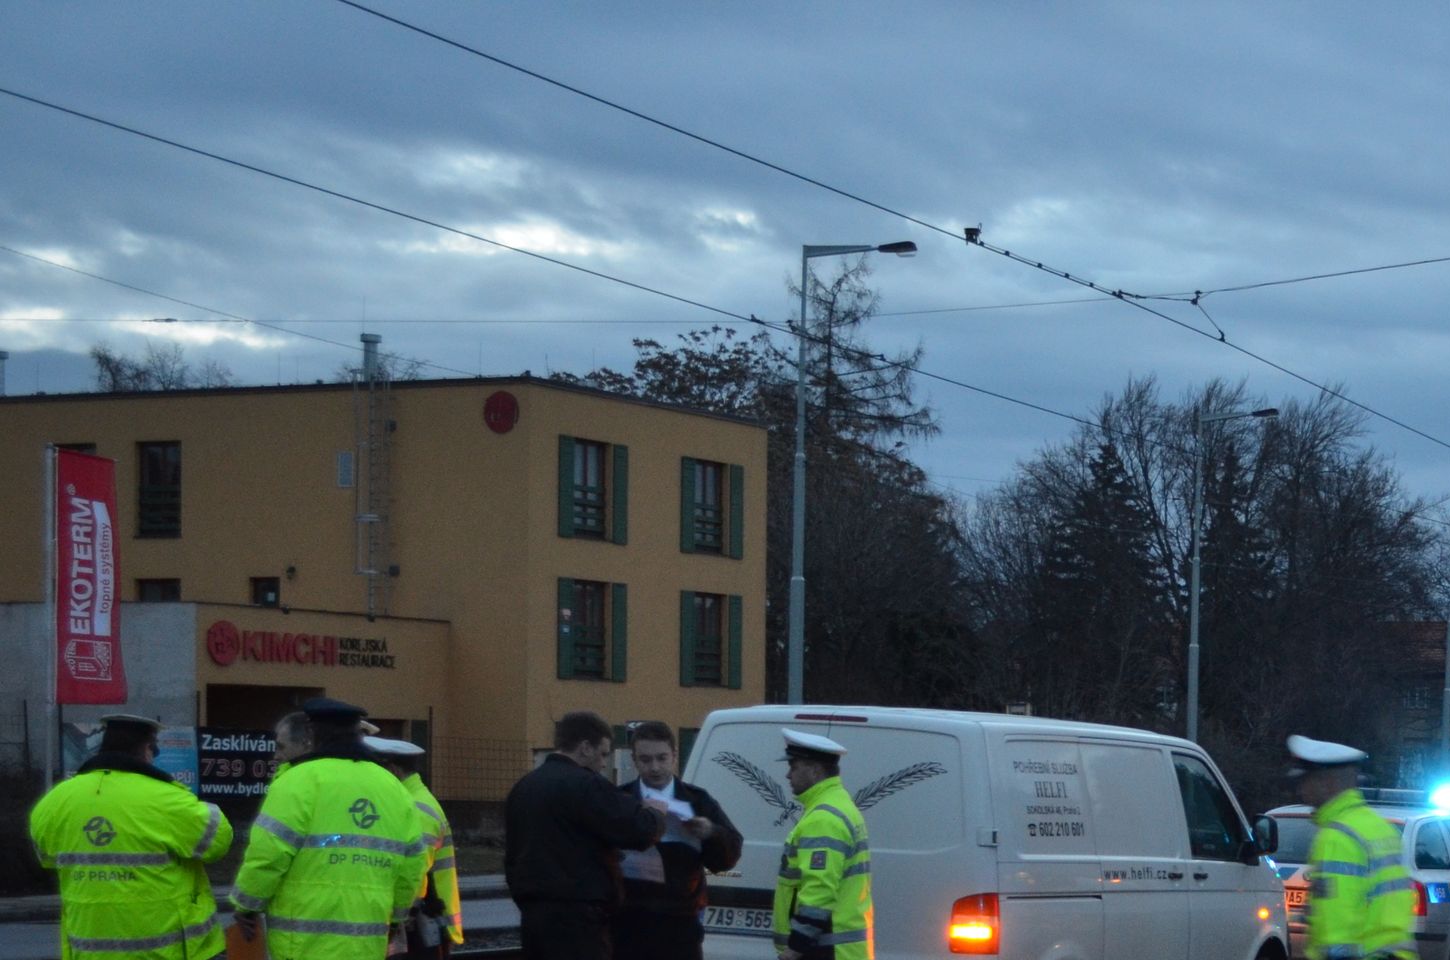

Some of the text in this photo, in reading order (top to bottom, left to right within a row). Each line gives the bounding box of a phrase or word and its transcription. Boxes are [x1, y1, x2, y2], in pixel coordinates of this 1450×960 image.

[70, 497, 93, 635] EKOTERM
[99, 522, 113, 614] topné systémy
[242, 630, 338, 667] KIMCHI
[338, 636, 388, 653] KOREJSKÁ
[338, 653, 397, 669] RESTAURACE
[201, 734, 276, 752] Zasklíván
[201, 758, 279, 777] 739 03
[201, 782, 271, 797] www.bydle
[1034, 780, 1068, 798] HELFI
[1039, 821, 1055, 837] 602
[1055, 821, 1070, 837] 210
[329, 853, 391, 868] DP PRAHA
[88, 870, 138, 881] PRAHA
[1104, 866, 1168, 880] www.helfi.cz
[706, 907, 774, 929] 7A9 565
